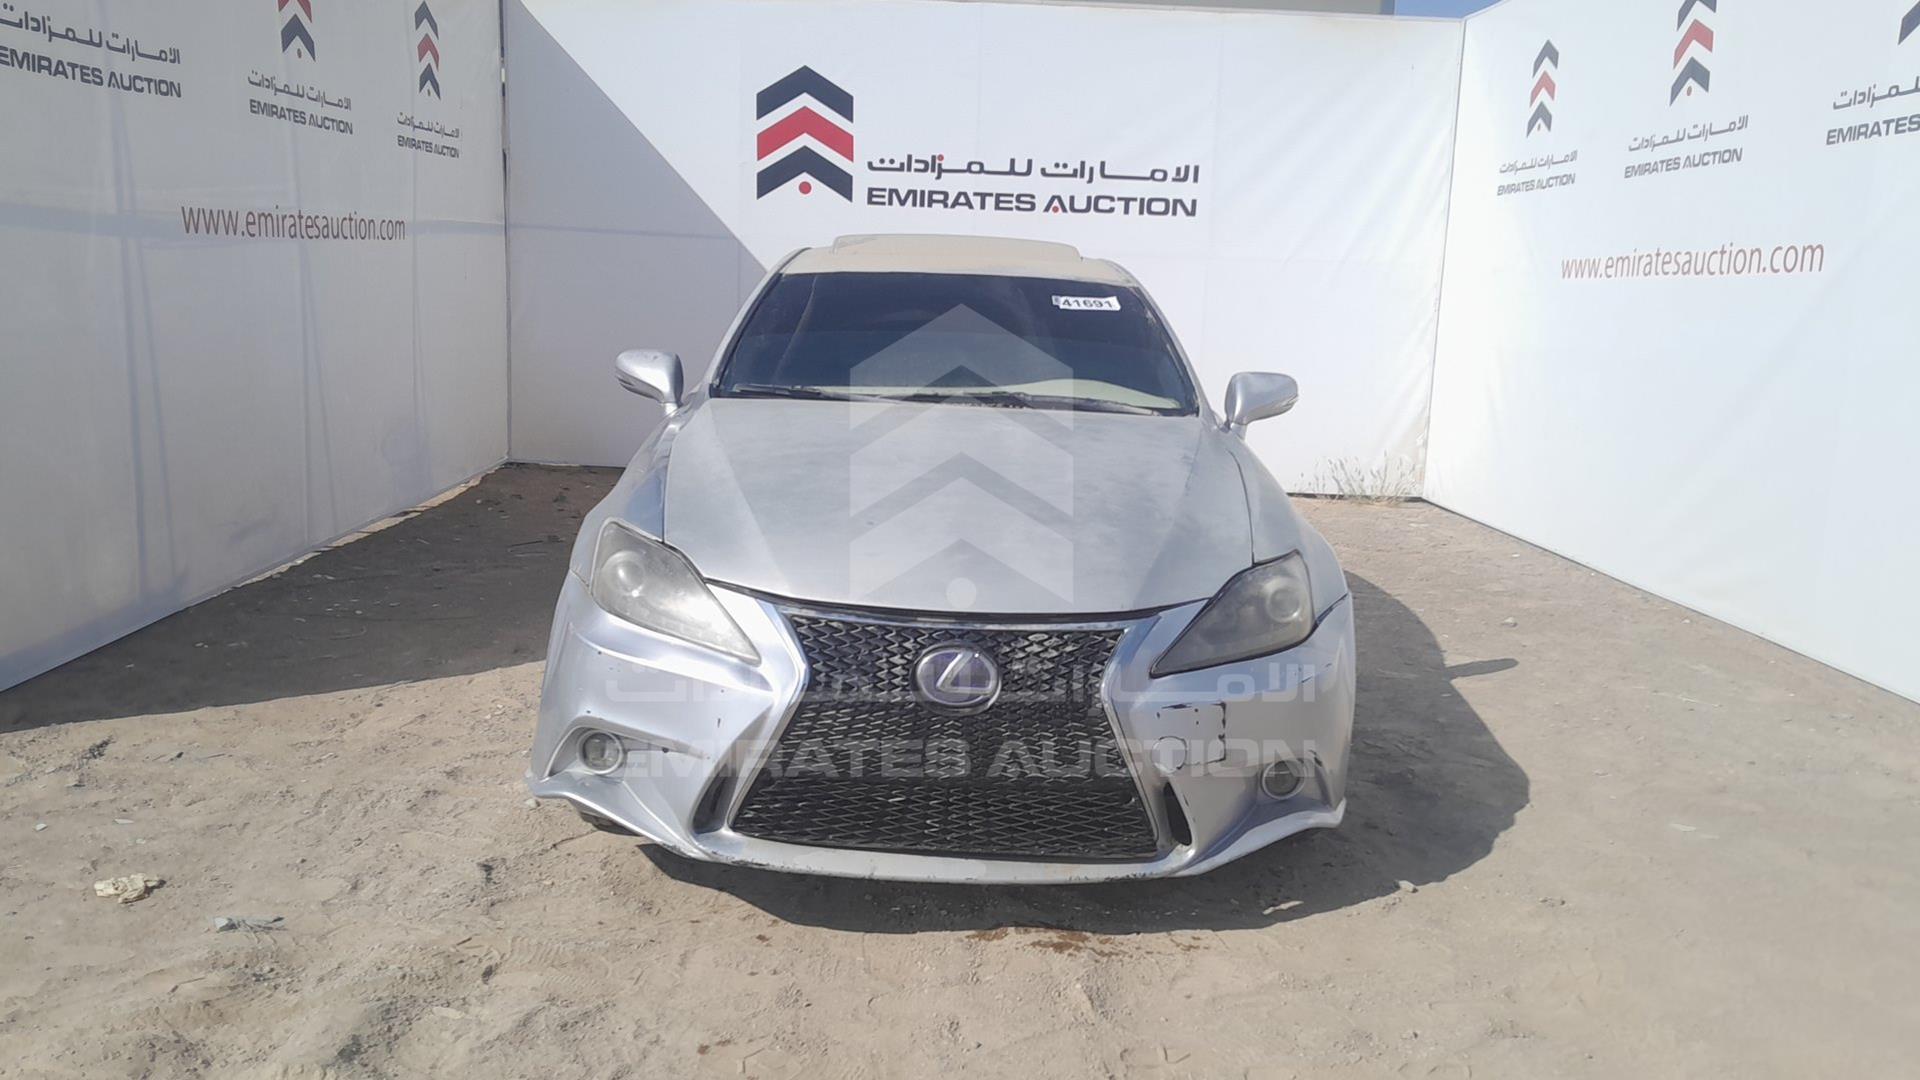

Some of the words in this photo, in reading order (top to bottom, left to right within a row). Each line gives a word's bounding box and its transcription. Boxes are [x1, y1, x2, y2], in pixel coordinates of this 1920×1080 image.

[0, 45, 104, 87] EMIRATES
[107, 71, 182, 99] AUCTION
[249, 98, 307, 126] EMIRATES
[308, 113, 353, 135] AUCTION
[1826, 113, 1920, 146] EMIRATES
[397, 135, 434, 153] EMIRATES
[434, 143, 460, 159] AUCTION
[1623, 156, 1681, 179] EMIRATES
[1683, 147, 1743, 170] AUCTION
[1497, 179, 1536, 196] EMIRATES
[1535, 173, 1576, 190] AUCTION
[866, 187, 1037, 213] EMIRATES
[1043, 195, 1197, 217] AUCTION
[1561, 242, 1825, 280] www.emiratesauction.com
[1062, 298, 1113, 308] 41691
